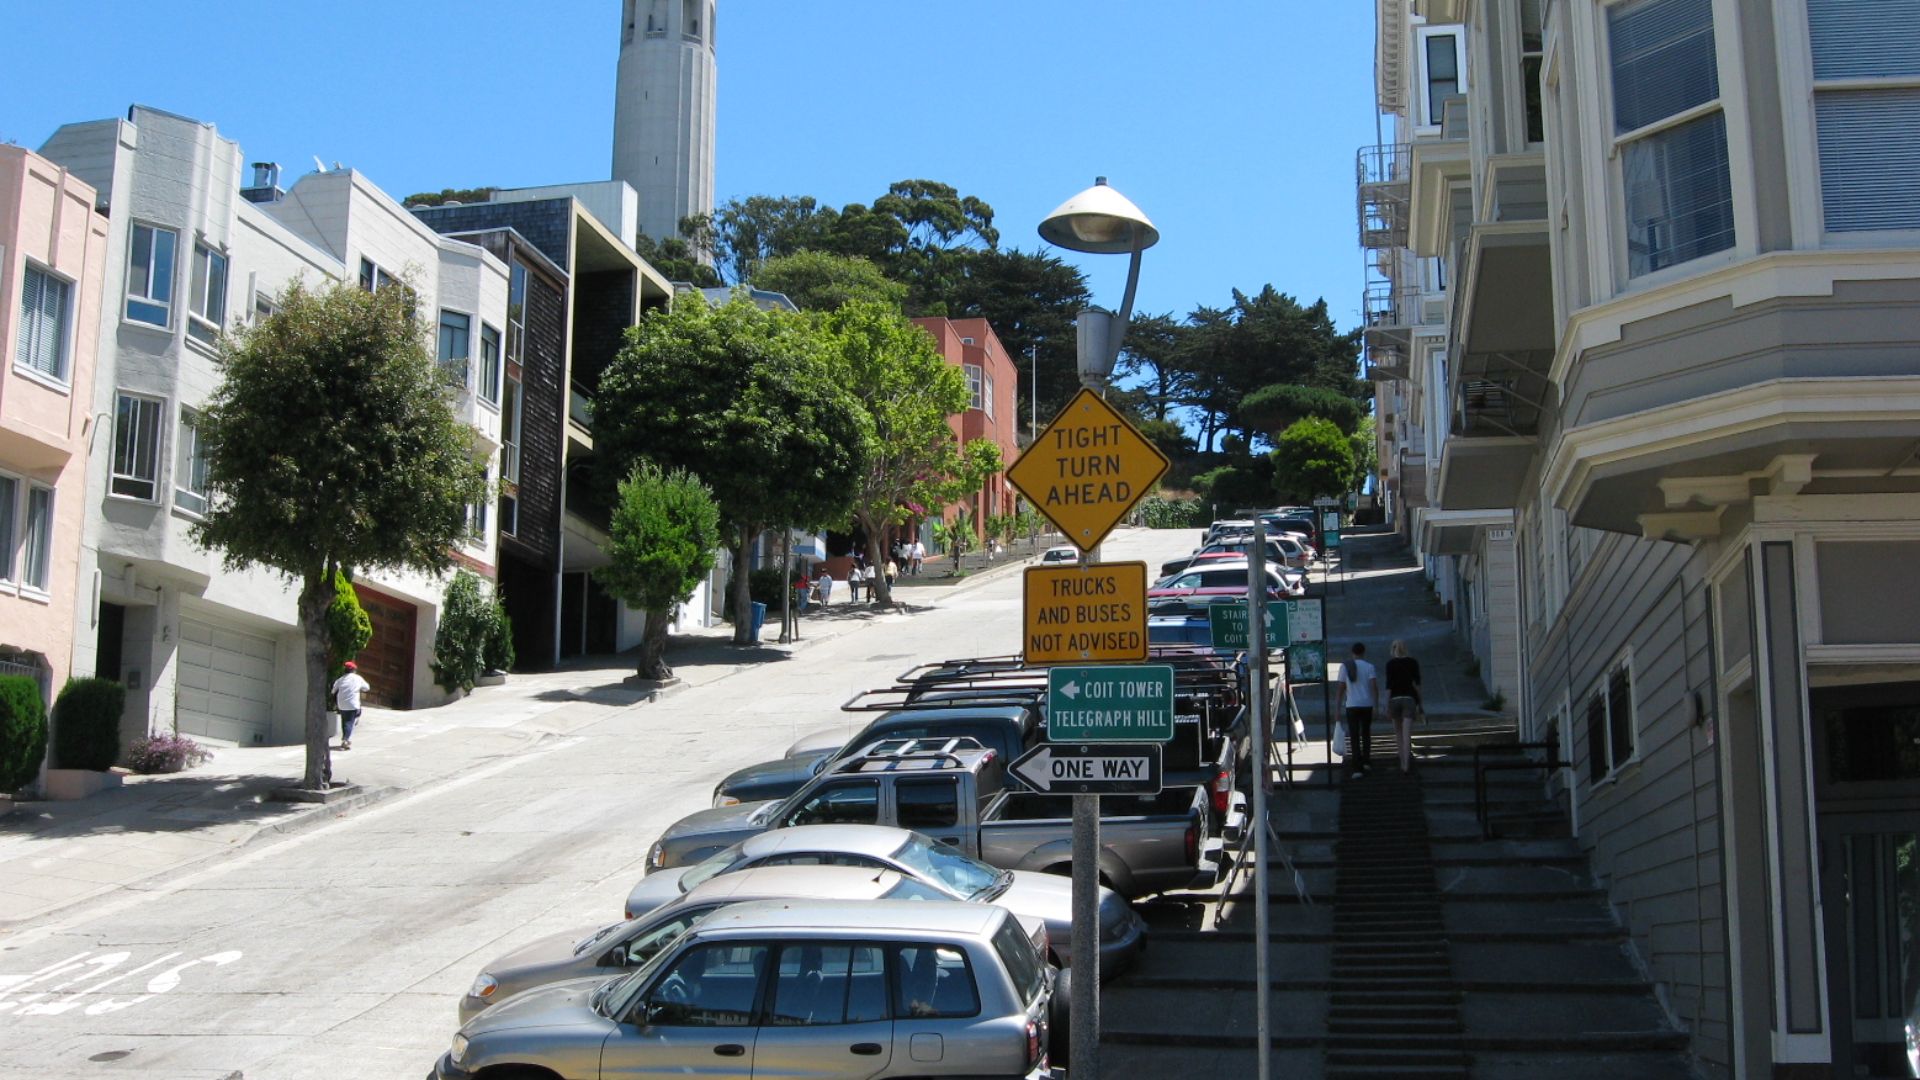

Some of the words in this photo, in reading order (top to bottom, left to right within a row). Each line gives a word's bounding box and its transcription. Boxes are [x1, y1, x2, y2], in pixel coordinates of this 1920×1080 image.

[1053, 425, 1121, 449] TIGHT
[1056, 454, 1120, 478] TURN
[1046, 481, 1130, 506] AHEAD
[1051, 576, 1116, 597] TRUCKS
[1038, 606, 1070, 624] AND
[1076, 603, 1131, 623] BUSES
[1222, 609, 1250, 620] STAIR
[1232, 622, 1243, 632] TO
[1031, 634, 1062, 652] NOT
[1068, 631, 1140, 651] ADVISED
[1224, 634, 1243, 643] COIT
[1246, 632, 1276, 643] TER
[1085, 681, 1114, 698] COIT
[1119, 681, 1163, 698] TOWER
[1055, 710, 1131, 727] TELEGRAPH
[1137, 710, 1166, 727] HILL
[1052, 760, 1094, 778] ONE
[1102, 760, 1143, 778] WAY
